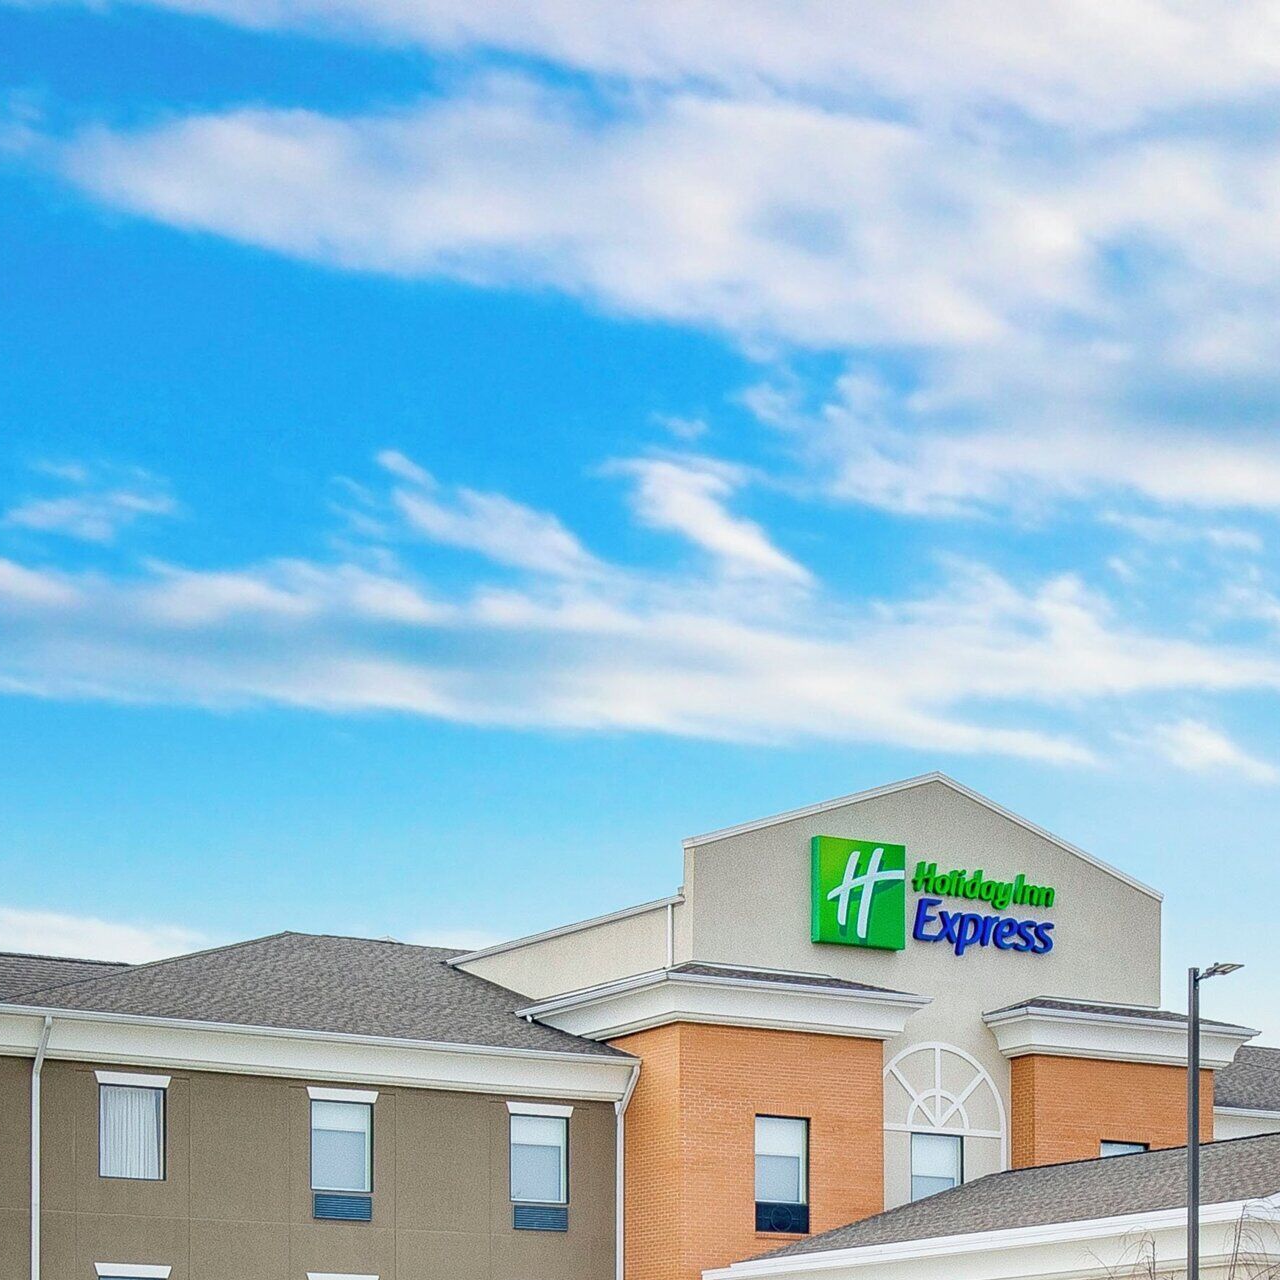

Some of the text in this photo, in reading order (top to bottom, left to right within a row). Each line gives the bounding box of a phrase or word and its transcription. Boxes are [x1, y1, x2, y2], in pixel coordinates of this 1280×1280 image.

[911, 861, 1056, 911] Holiday Inn
[912, 897, 1055, 956] Express
